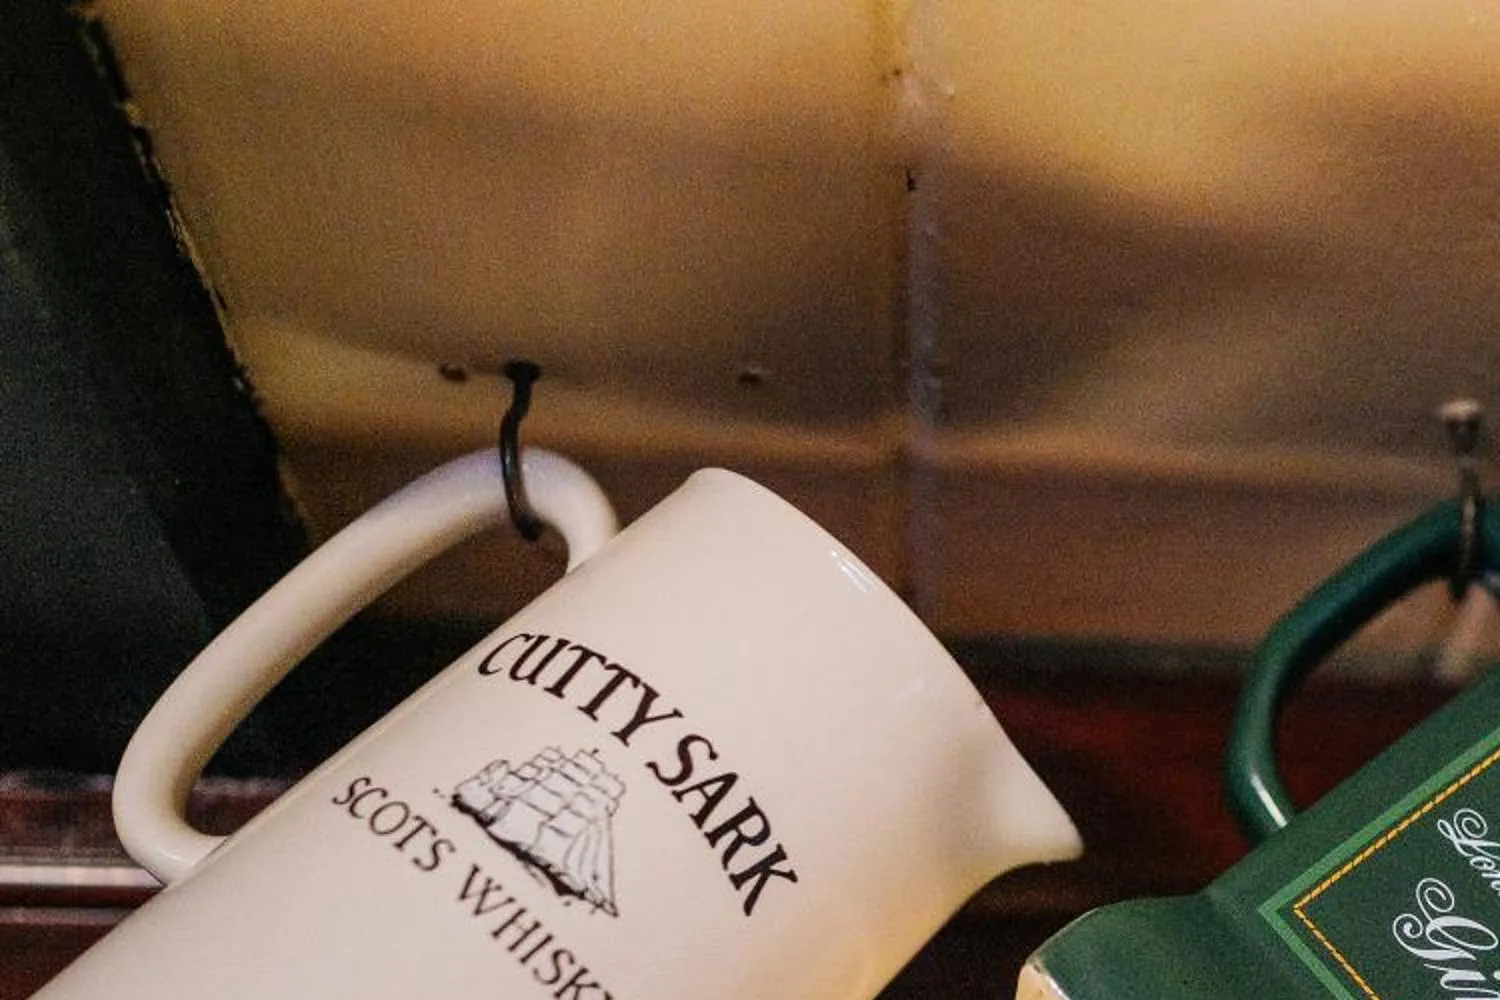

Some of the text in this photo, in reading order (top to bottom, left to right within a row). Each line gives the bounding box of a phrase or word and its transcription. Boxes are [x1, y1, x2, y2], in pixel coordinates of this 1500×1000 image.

[332, 776, 456, 873] SCOTS
[477, 632, 799, 917] CUTTY SARK
